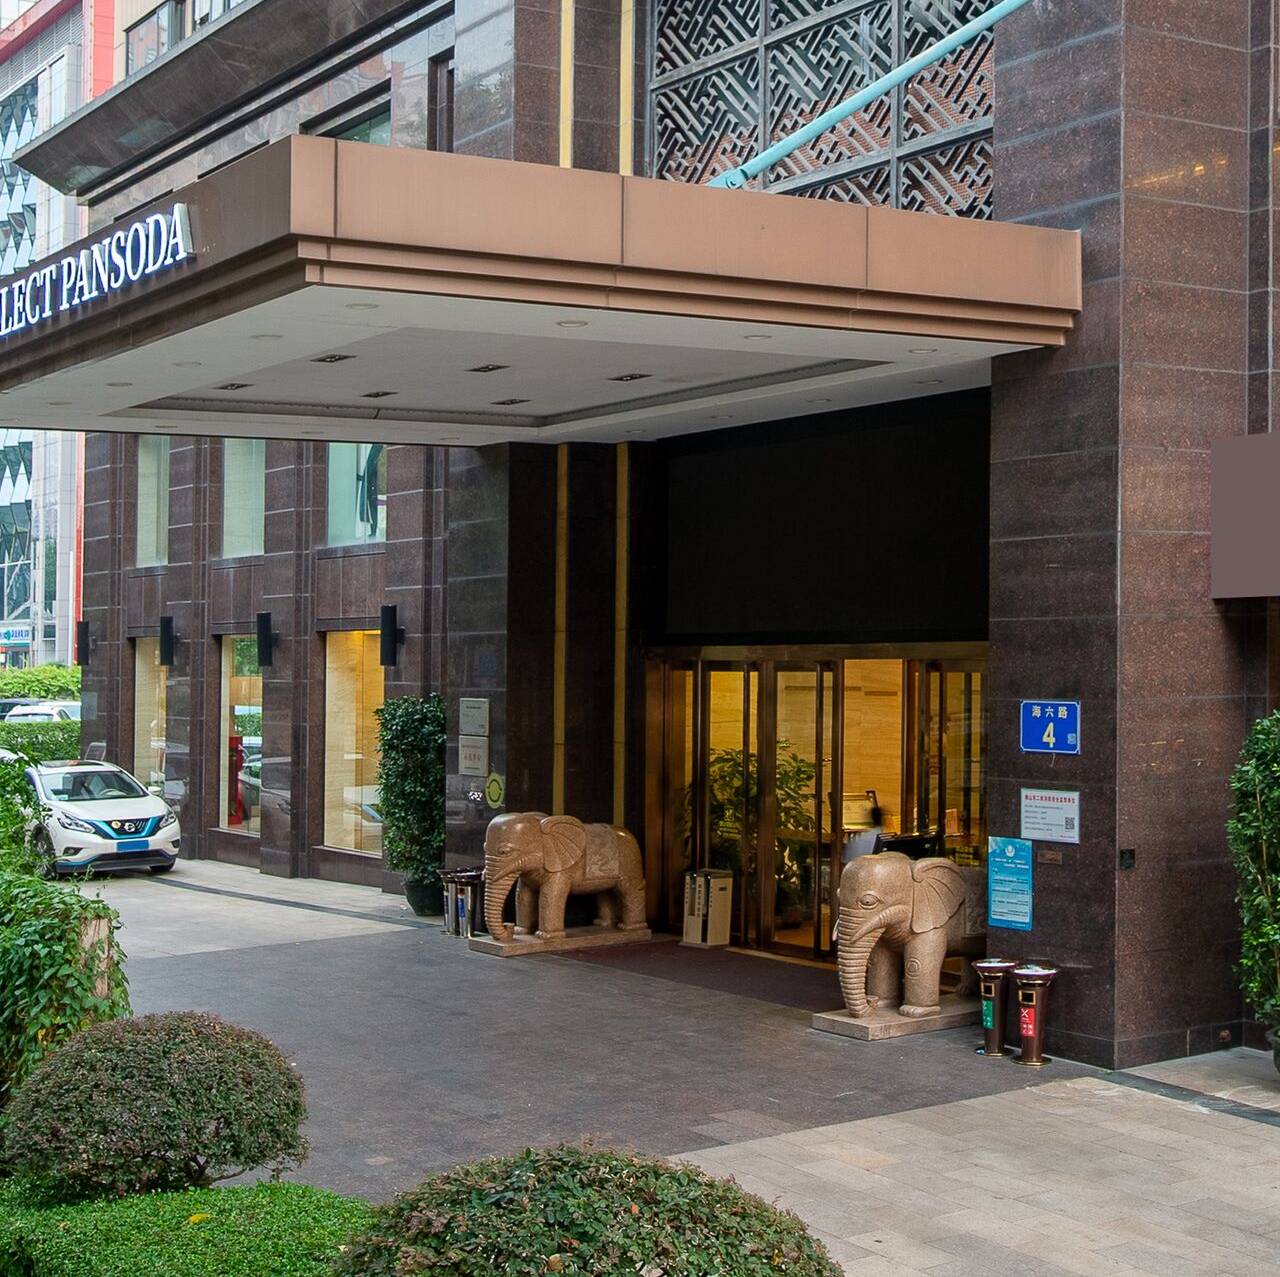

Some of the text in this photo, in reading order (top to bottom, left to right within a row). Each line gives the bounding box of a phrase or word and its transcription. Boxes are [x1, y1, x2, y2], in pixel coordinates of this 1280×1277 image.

[59, 203, 188, 311] PANSODA
[1032, 705, 1068, 719] 海六路
[1042, 721, 1056, 749] 4
